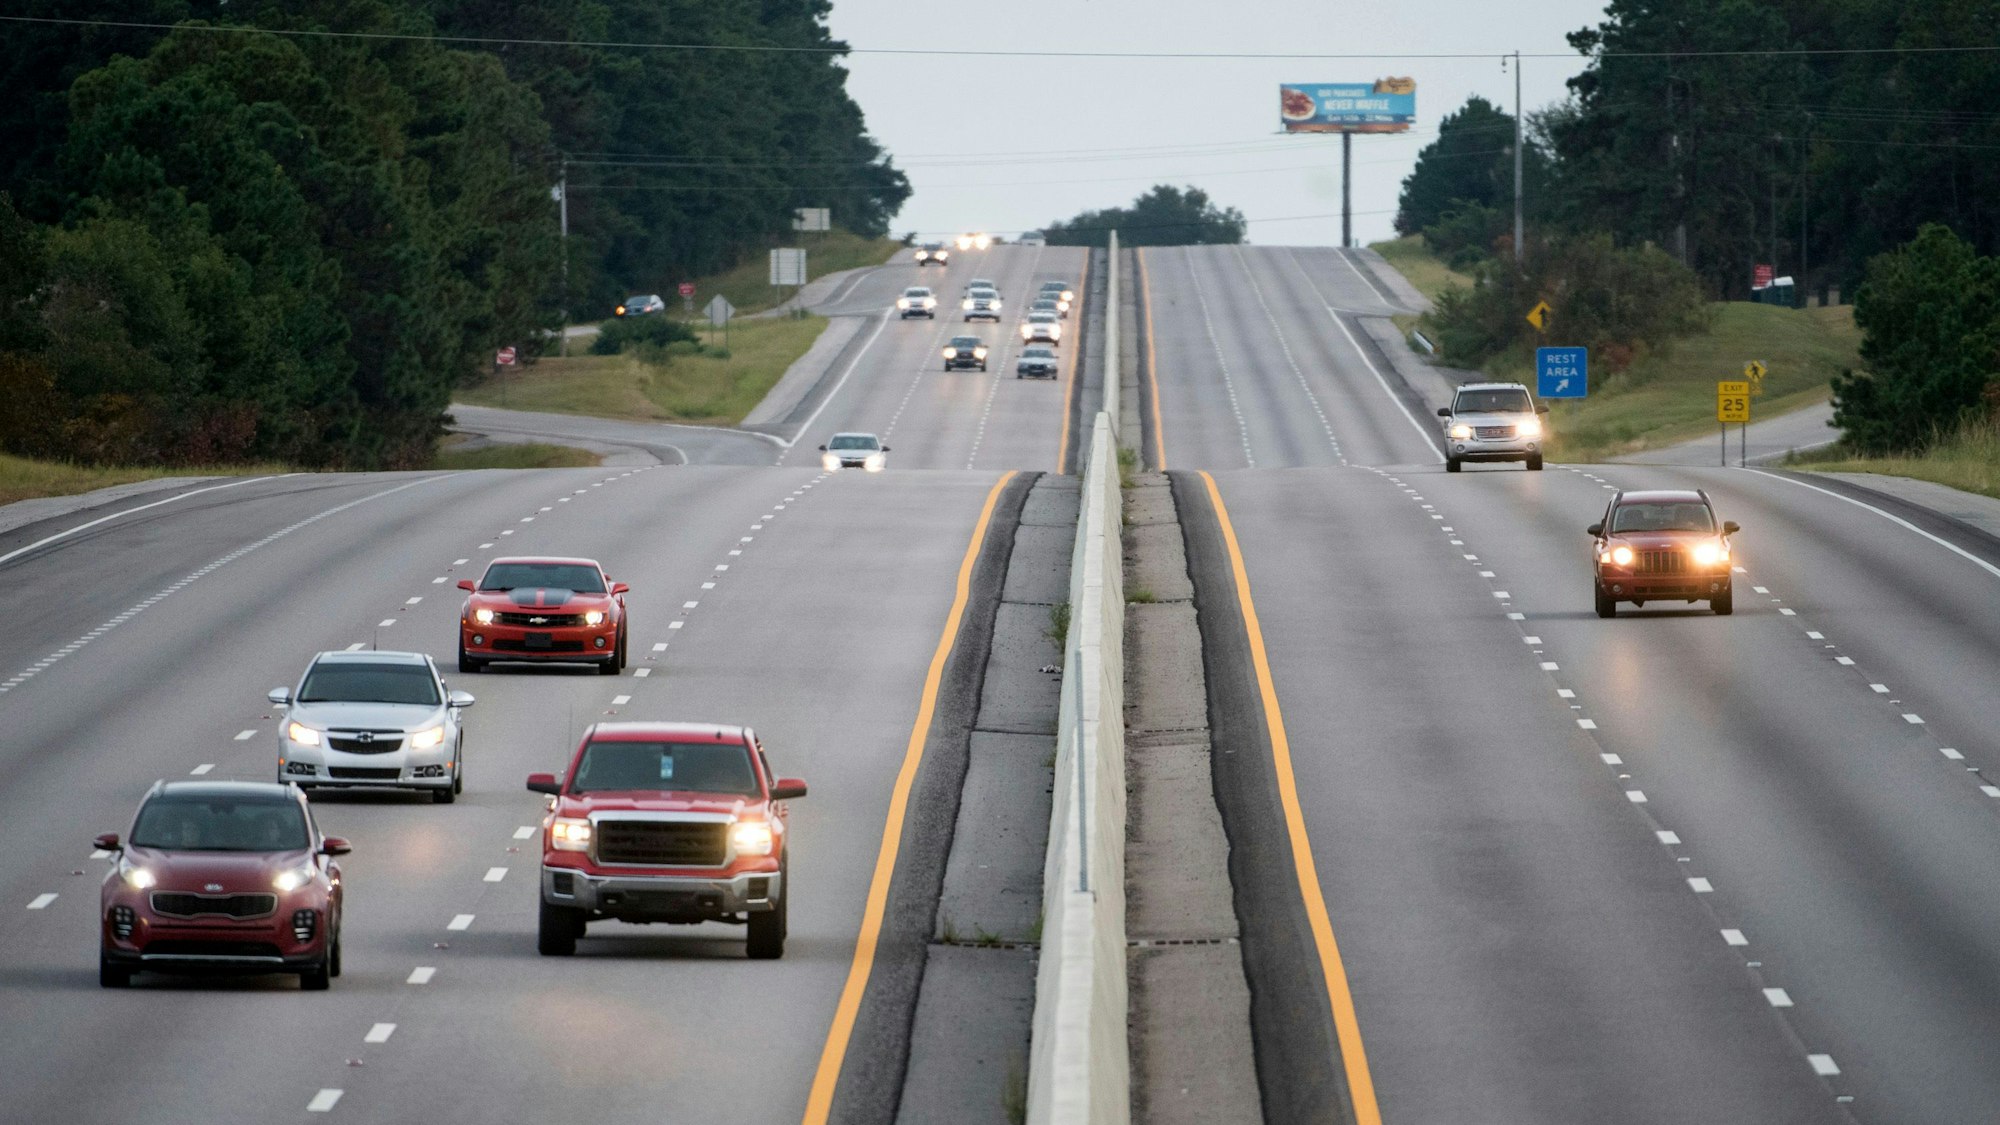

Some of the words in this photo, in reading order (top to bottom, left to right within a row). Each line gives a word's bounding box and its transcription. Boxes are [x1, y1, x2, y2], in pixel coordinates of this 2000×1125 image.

[1325, 99, 1353, 110] NEVER
[1355, 99, 1389, 110] WAFFLE
[1547, 354, 1576, 363] REST
[1546, 367, 1578, 376] AREA
[1723, 398, 1744, 411] 25
